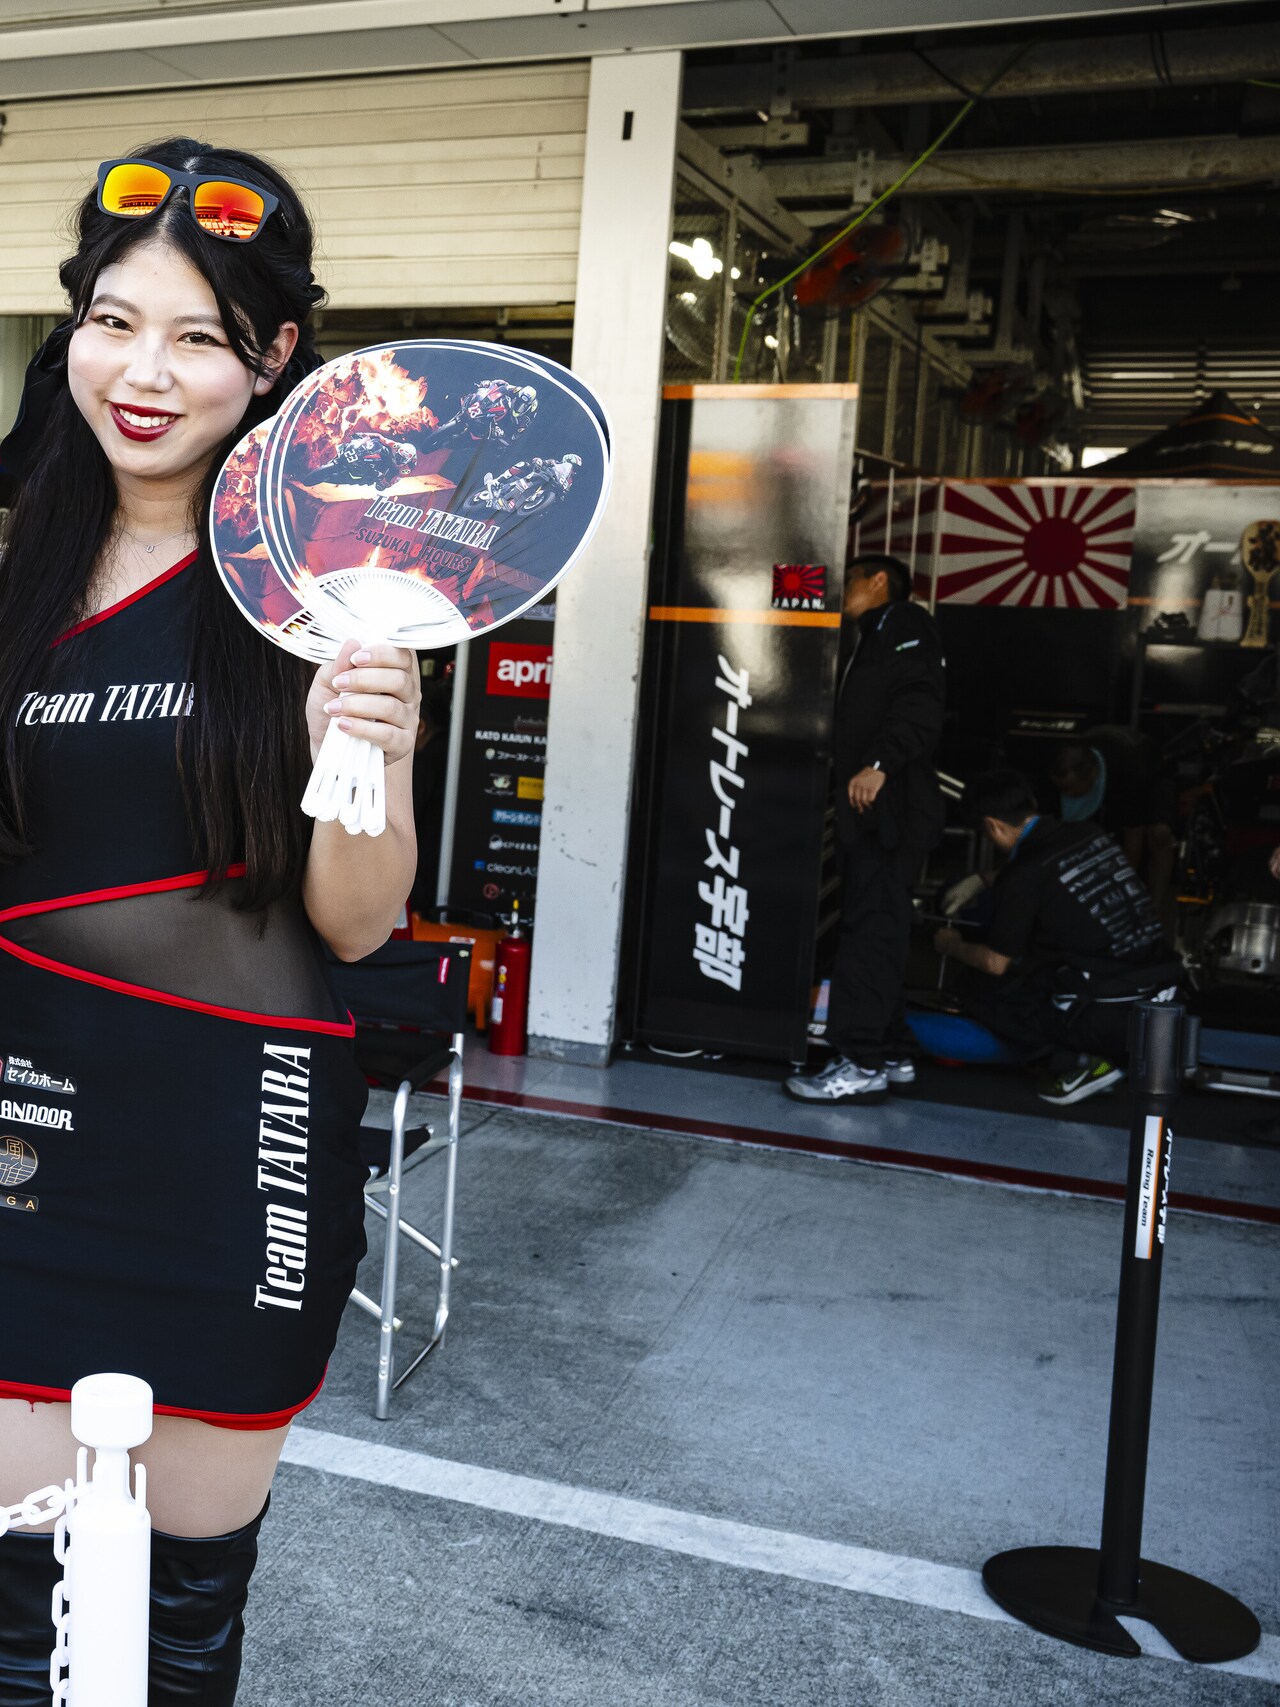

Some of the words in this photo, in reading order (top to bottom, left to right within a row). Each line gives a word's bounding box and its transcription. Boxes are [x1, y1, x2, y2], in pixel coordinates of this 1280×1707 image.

[364, 494, 424, 530] Team
[417, 508, 501, 551] TATARA
[355, 526, 411, 555] SUZUKA
[410, 543, 422, 558] 8
[421, 545, 471, 572] HOURS
[15, 691, 95, 727] Team
[99, 682, 195, 722] TATAR
[474, 730, 500, 741] KATO
[692, 652, 754, 992] オートレース宇部
[7, 1067, 76, 1093] セイカホーム
[8, 1056, 33, 1069] 株式会社
[257, 1042, 312, 1196] TATARA
[1142, 1148, 1155, 1191] Racing
[1140, 1195, 1151, 1227] Team
[254, 1203, 308, 1311] Team
